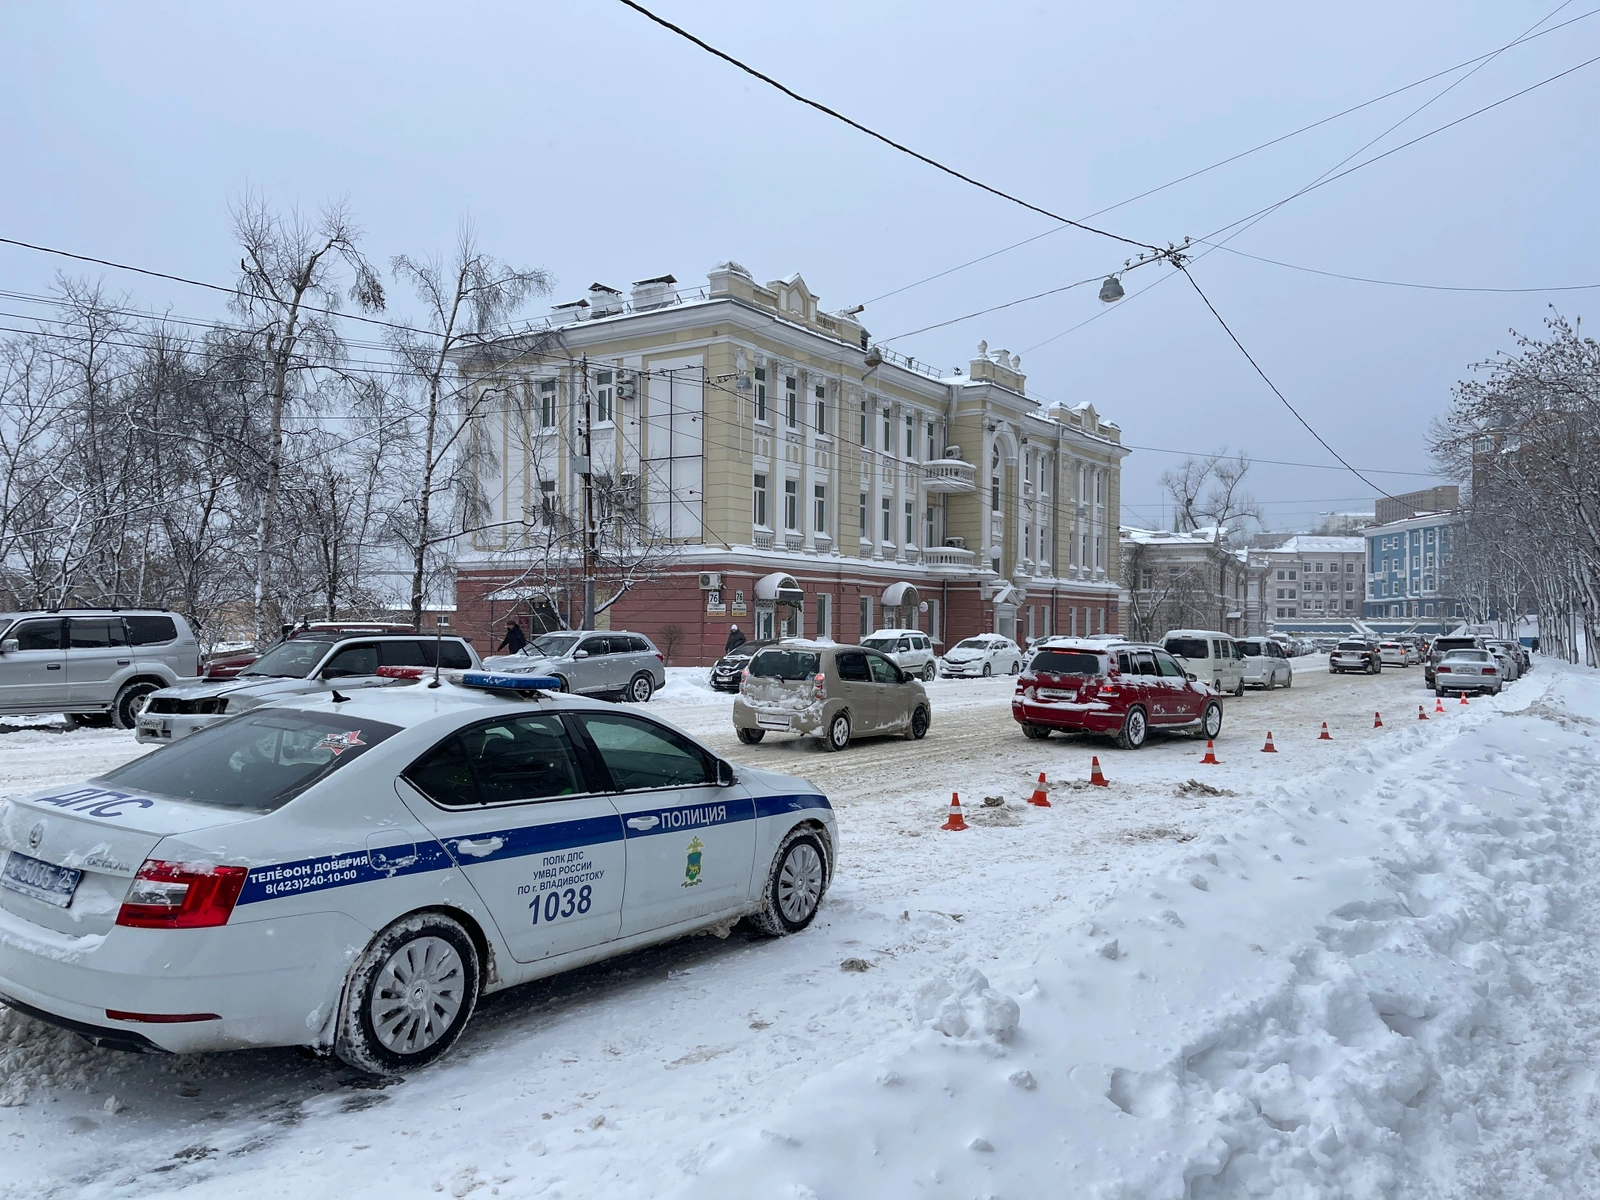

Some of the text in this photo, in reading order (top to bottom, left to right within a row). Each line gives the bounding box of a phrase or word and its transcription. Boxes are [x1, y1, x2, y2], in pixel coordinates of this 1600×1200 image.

[709, 594, 718, 603] 76
[33, 788, 154, 818] ДПС
[661, 805, 727, 829] ПОЛИЦИЯ
[249, 855, 369, 884] ТЕЛЕФОН ДОВЕРИЯ
[533, 861, 592, 881] УМВД РОССИИ
[542, 851, 584, 867] ПОЛК ДПС
[265, 869, 357, 895] 8(423)240-10-00
[517, 885, 530, 896] ПО
[539, 870, 605, 891] ВЛАДИВОСТОКУ
[528, 884, 592, 925] 1038
